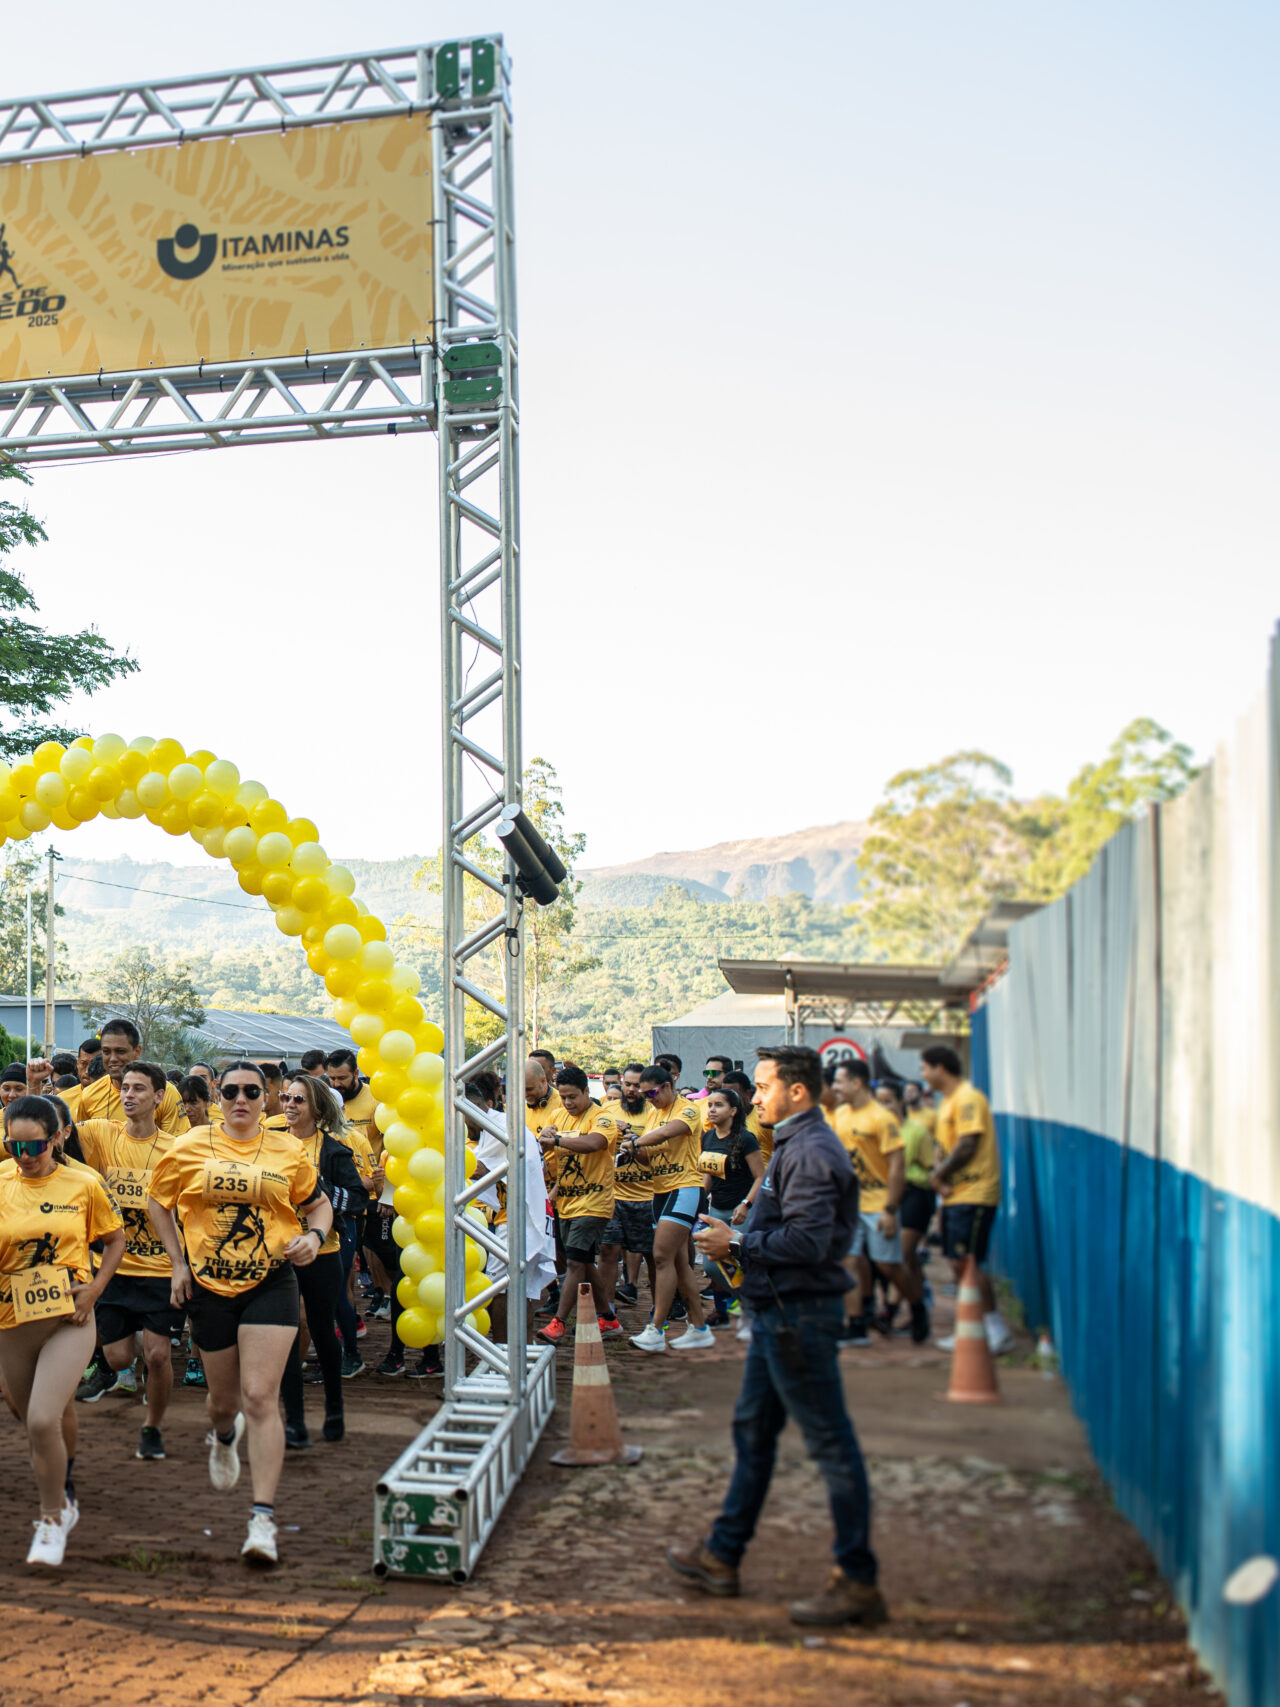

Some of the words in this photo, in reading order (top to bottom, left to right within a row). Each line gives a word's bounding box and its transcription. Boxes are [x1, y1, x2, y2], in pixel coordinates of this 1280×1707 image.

[222, 226, 350, 258] ITAMINAS
[21, 286, 48, 299] DE
[28, 314, 58, 328] 2025
[653, 1166, 685, 1177] ZEDO
[702, 1162, 718, 1171] 143
[117, 1184, 142, 1197] 038
[213, 1177, 248, 1193] 235
[204, 1257, 264, 1268] TRILHAS
[193, 1262, 266, 1281] ARZE
[25, 1285, 61, 1305] 096
